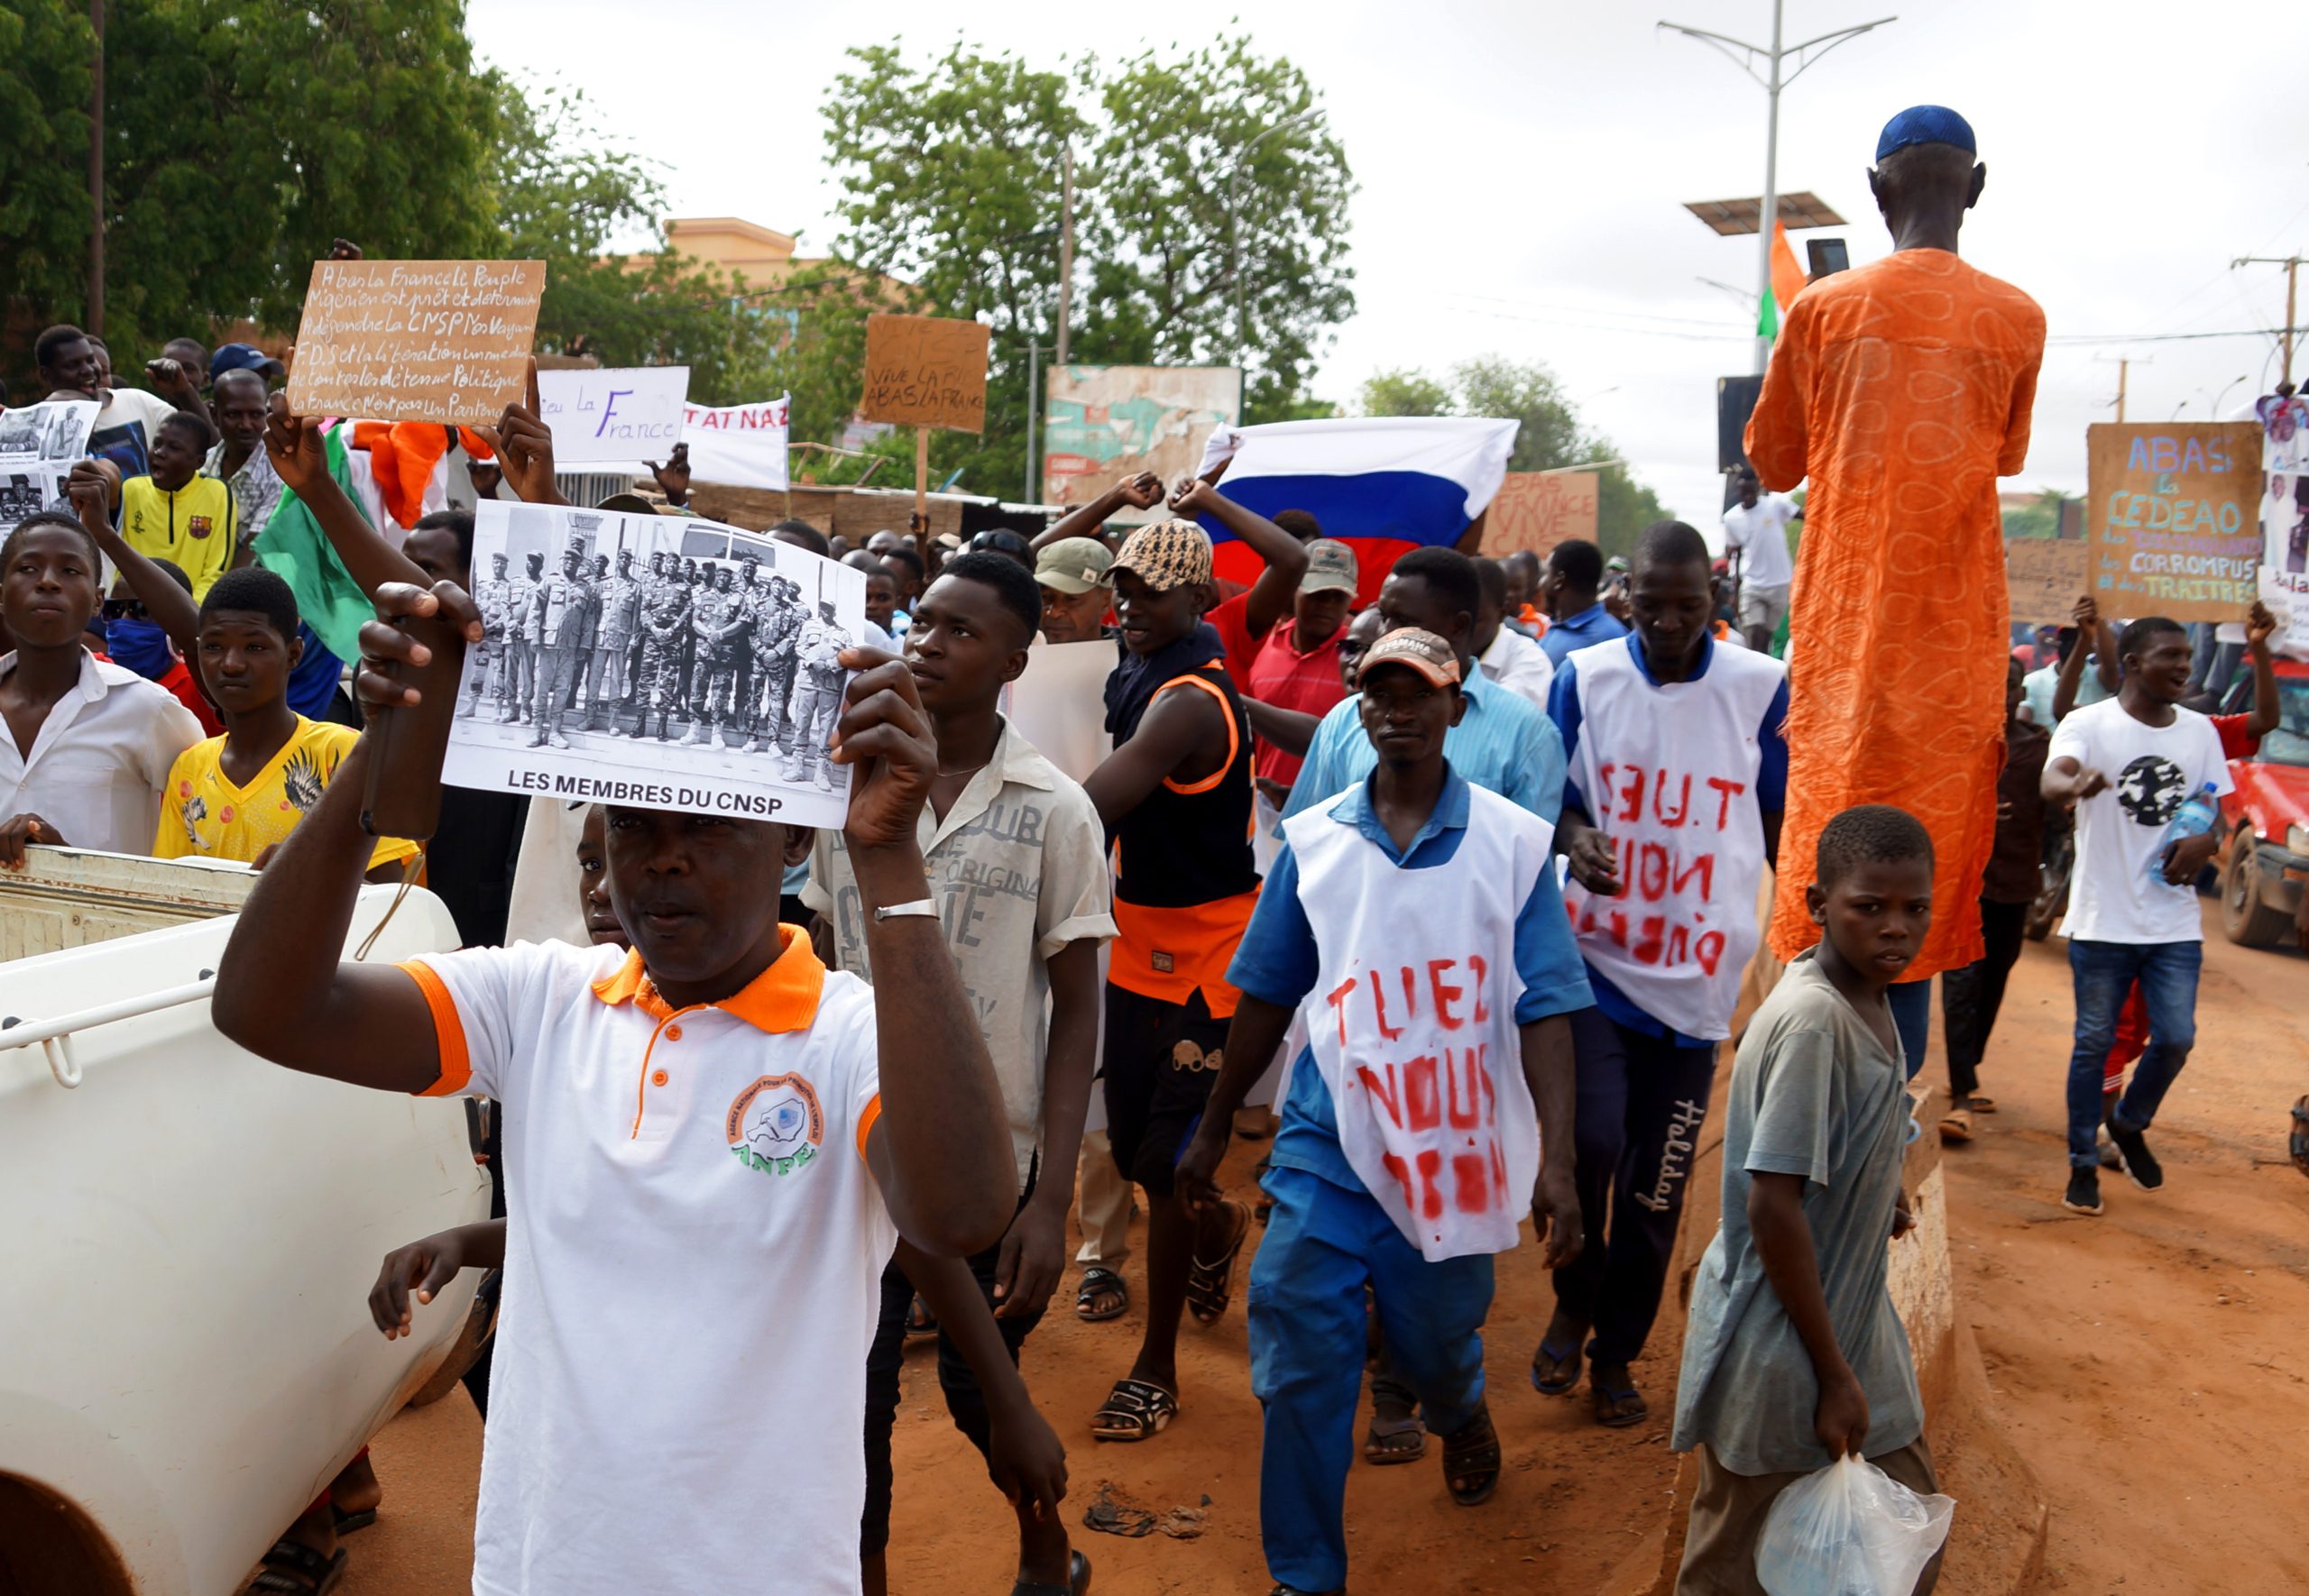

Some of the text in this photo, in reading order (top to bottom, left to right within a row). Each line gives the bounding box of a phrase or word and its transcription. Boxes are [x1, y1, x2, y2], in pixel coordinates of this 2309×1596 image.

[474, 264, 526, 293] Peuple
[408, 310, 464, 337] CNSP
[595, 390, 675, 439] France
[2127, 436, 2234, 473] ABAS
[2109, 490, 2242, 534] CEDEAO
[2130, 552, 2256, 581] CORROMPUS
[508, 769, 783, 816] LES MEMBRES DU CNSP
[731, 1141, 818, 1177] ANPE
[1633, 1098, 1706, 1212] Holiday
